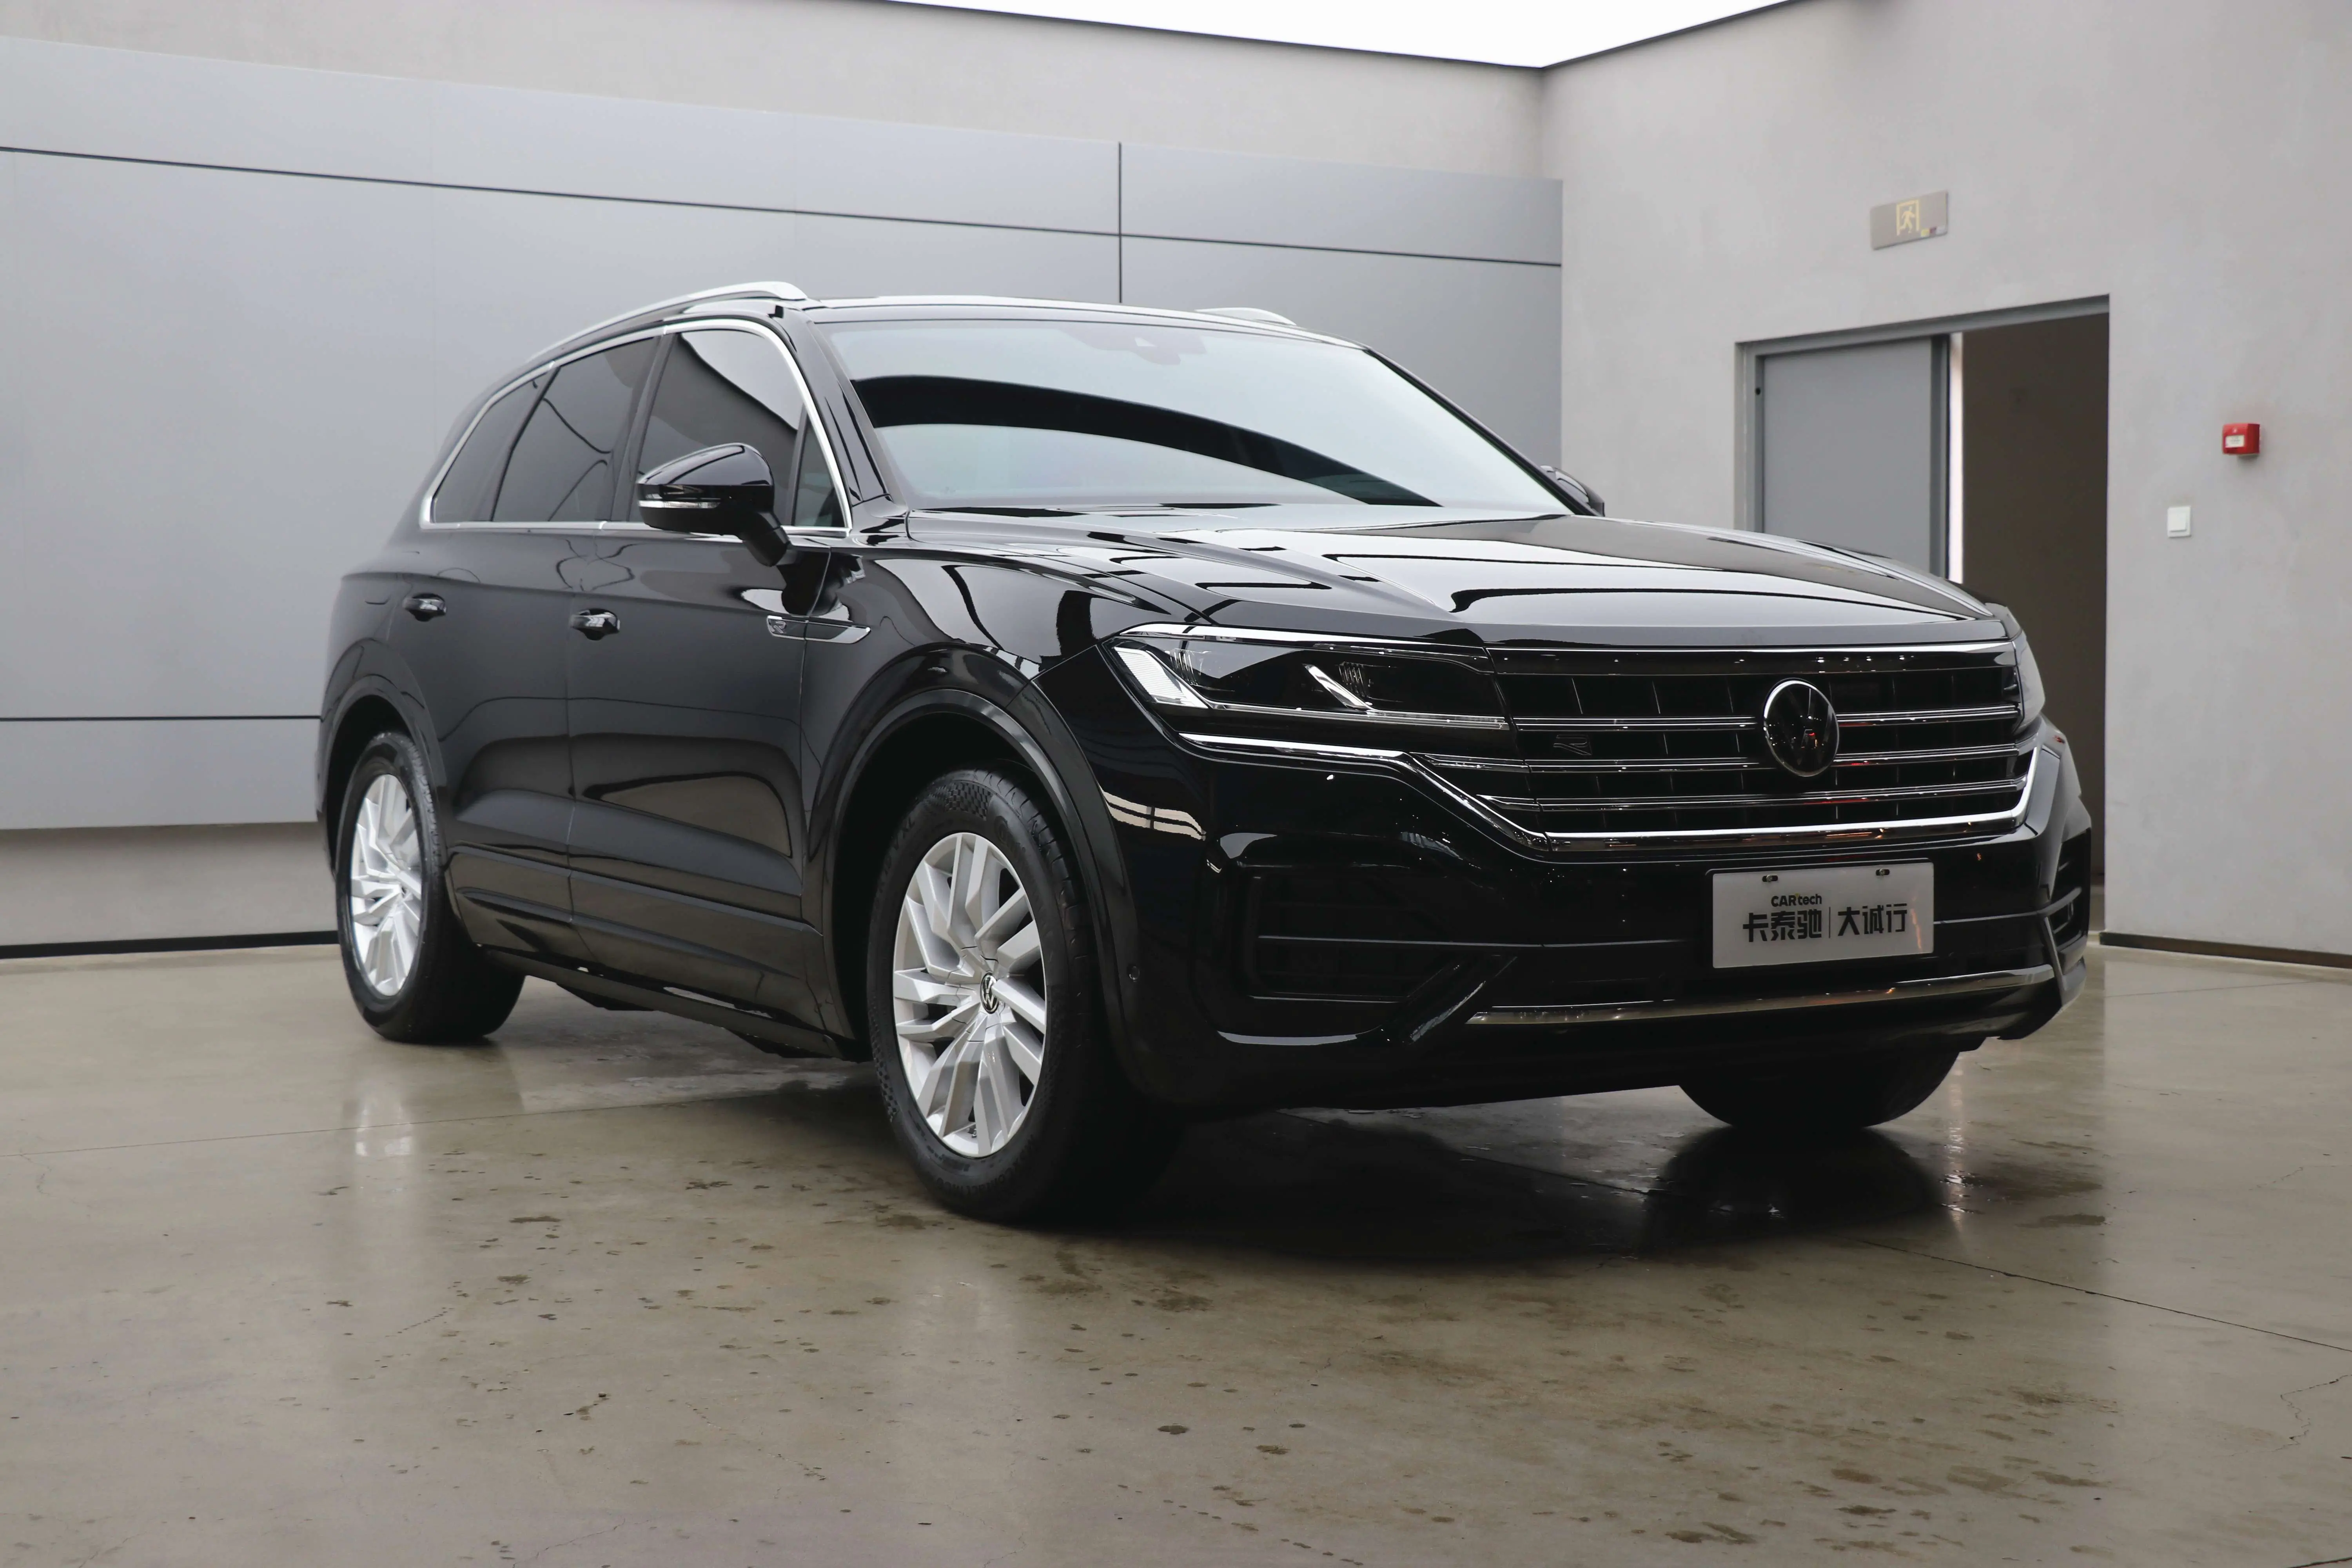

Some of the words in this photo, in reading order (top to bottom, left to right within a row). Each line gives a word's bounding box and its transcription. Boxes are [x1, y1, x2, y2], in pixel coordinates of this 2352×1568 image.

[1771, 893, 1822, 907] CARtech
[1743, 909, 1822, 942] 卡泰驰
[1838, 903, 1907, 936] 大诚行
